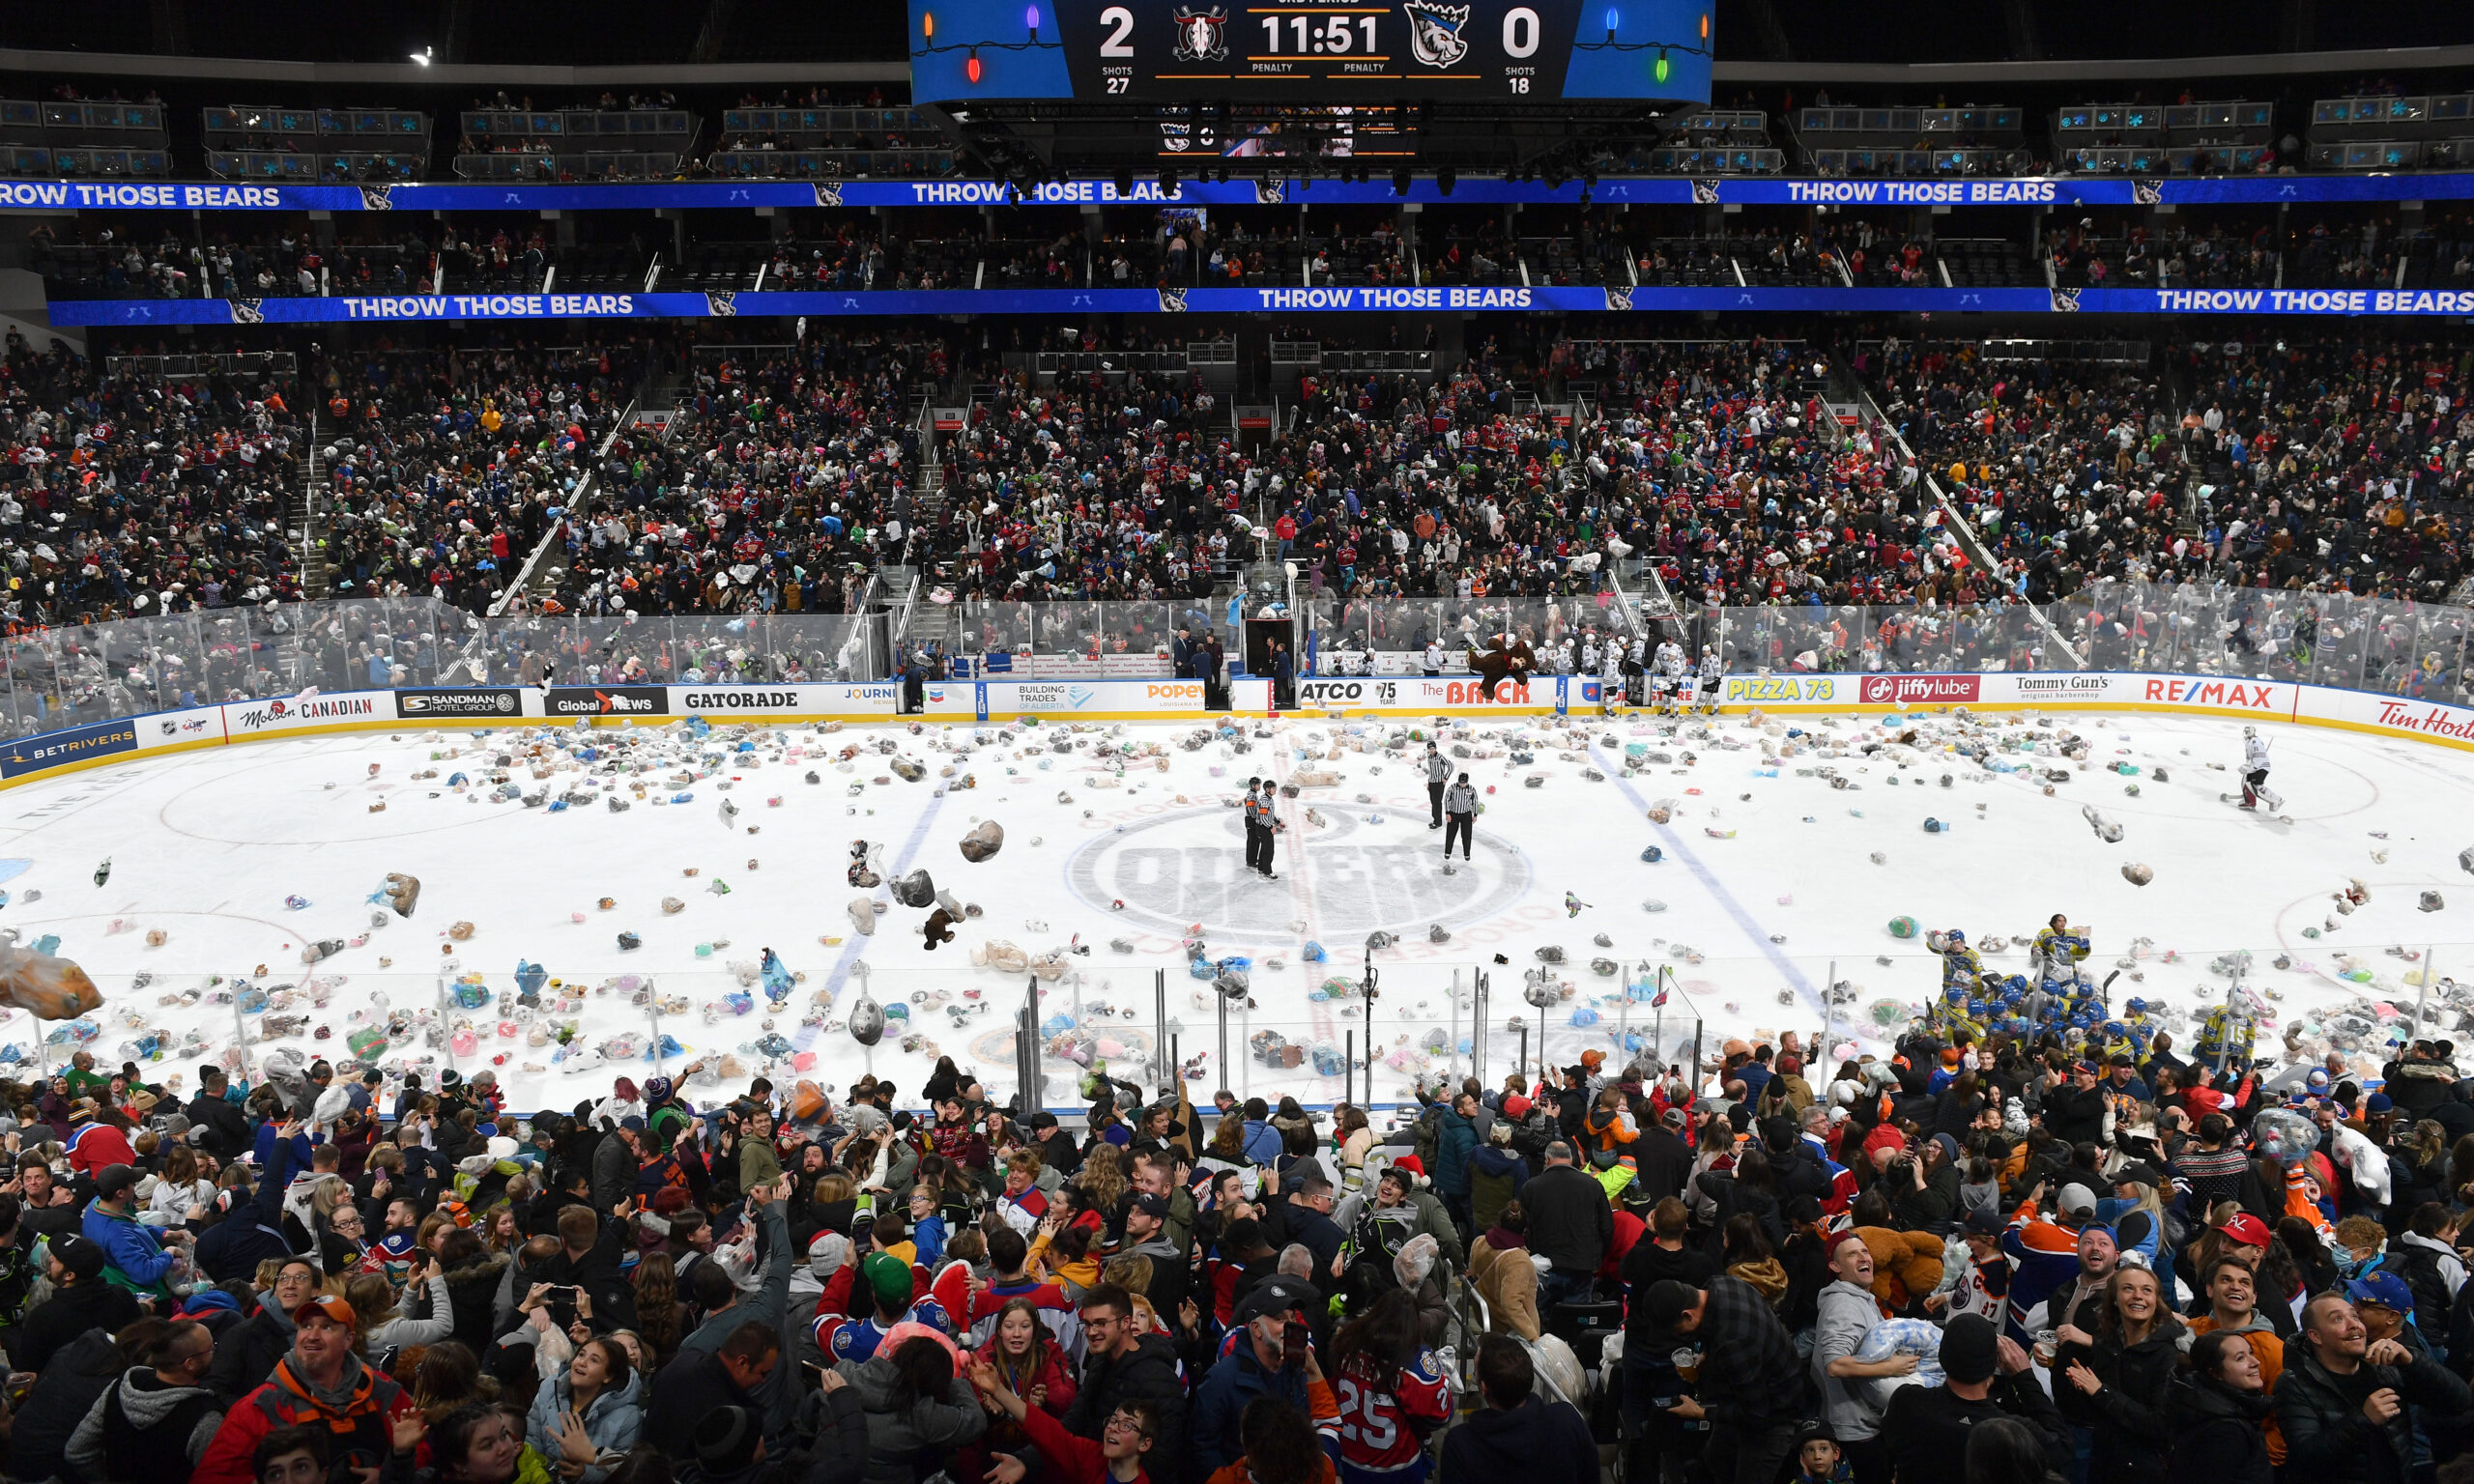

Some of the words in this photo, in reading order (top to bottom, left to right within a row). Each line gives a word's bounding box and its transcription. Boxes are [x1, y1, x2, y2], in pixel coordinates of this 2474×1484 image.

[1100, 6, 1135, 57] 2
[1261, 16, 1376, 53] 11:51
[1503, 7, 1540, 58] 0
[1102, 67, 1133, 76] SHOTS
[1252, 64, 1293, 72] PENALTY
[1344, 64, 1385, 72] PENALTY
[1505, 67, 1536, 76] SHOTS
[1107, 78, 1130, 94] 27
[1509, 78, 1530, 94] 18
[76, 185, 176, 206] THOSE
[185, 186, 280, 207] BEARS
[912, 183, 1005, 202] THROW
[1019, 182, 1093, 201] HOSE
[1788, 182, 1878, 201] THROW
[1884, 183, 1963, 202] THOSE
[1971, 182, 2056, 202] BEARS
[343, 297, 446, 318] THROW
[454, 296, 543, 316] THOSE
[550, 295, 633, 315] BEARS
[1259, 289, 1353, 308] THROW
[1359, 289, 1441, 307] THOSE
[1450, 289, 1532, 307] BEARS
[2157, 291, 2262, 310] THROW
[2271, 291, 2367, 311] THOSE
[2374, 292, 2474, 312] BEARS
[94, 428, 106, 438] 30
[1301, 682, 1363, 699] ATCO
[1379, 682, 1395, 699] 75
[1422, 683, 1444, 696] The
[1728, 679, 1800, 699] PIZZA
[1805, 679, 1834, 699] 73
[1895, 679, 1934, 699] jiffy
[1935, 679, 1971, 696] lube
[2016, 676, 2067, 691] Tommy
[2071, 675, 2109, 689] Gun's
[432, 695, 495, 704] SANDMAN
[685, 692, 798, 708] GATORADE
[2145, 679, 2273, 708] RE/MAX
[240, 708, 296, 728] Molson
[302, 699, 373, 718] CANADIAN
[558, 699, 600, 712] Global
[2379, 700, 2417, 728] Tim
[34, 730, 134, 759] BETRIVERS
[2229, 1025, 2247, 1043] 15
[1973, 1274, 1983, 1290] C
[1338, 1378, 1396, 1449] 25
